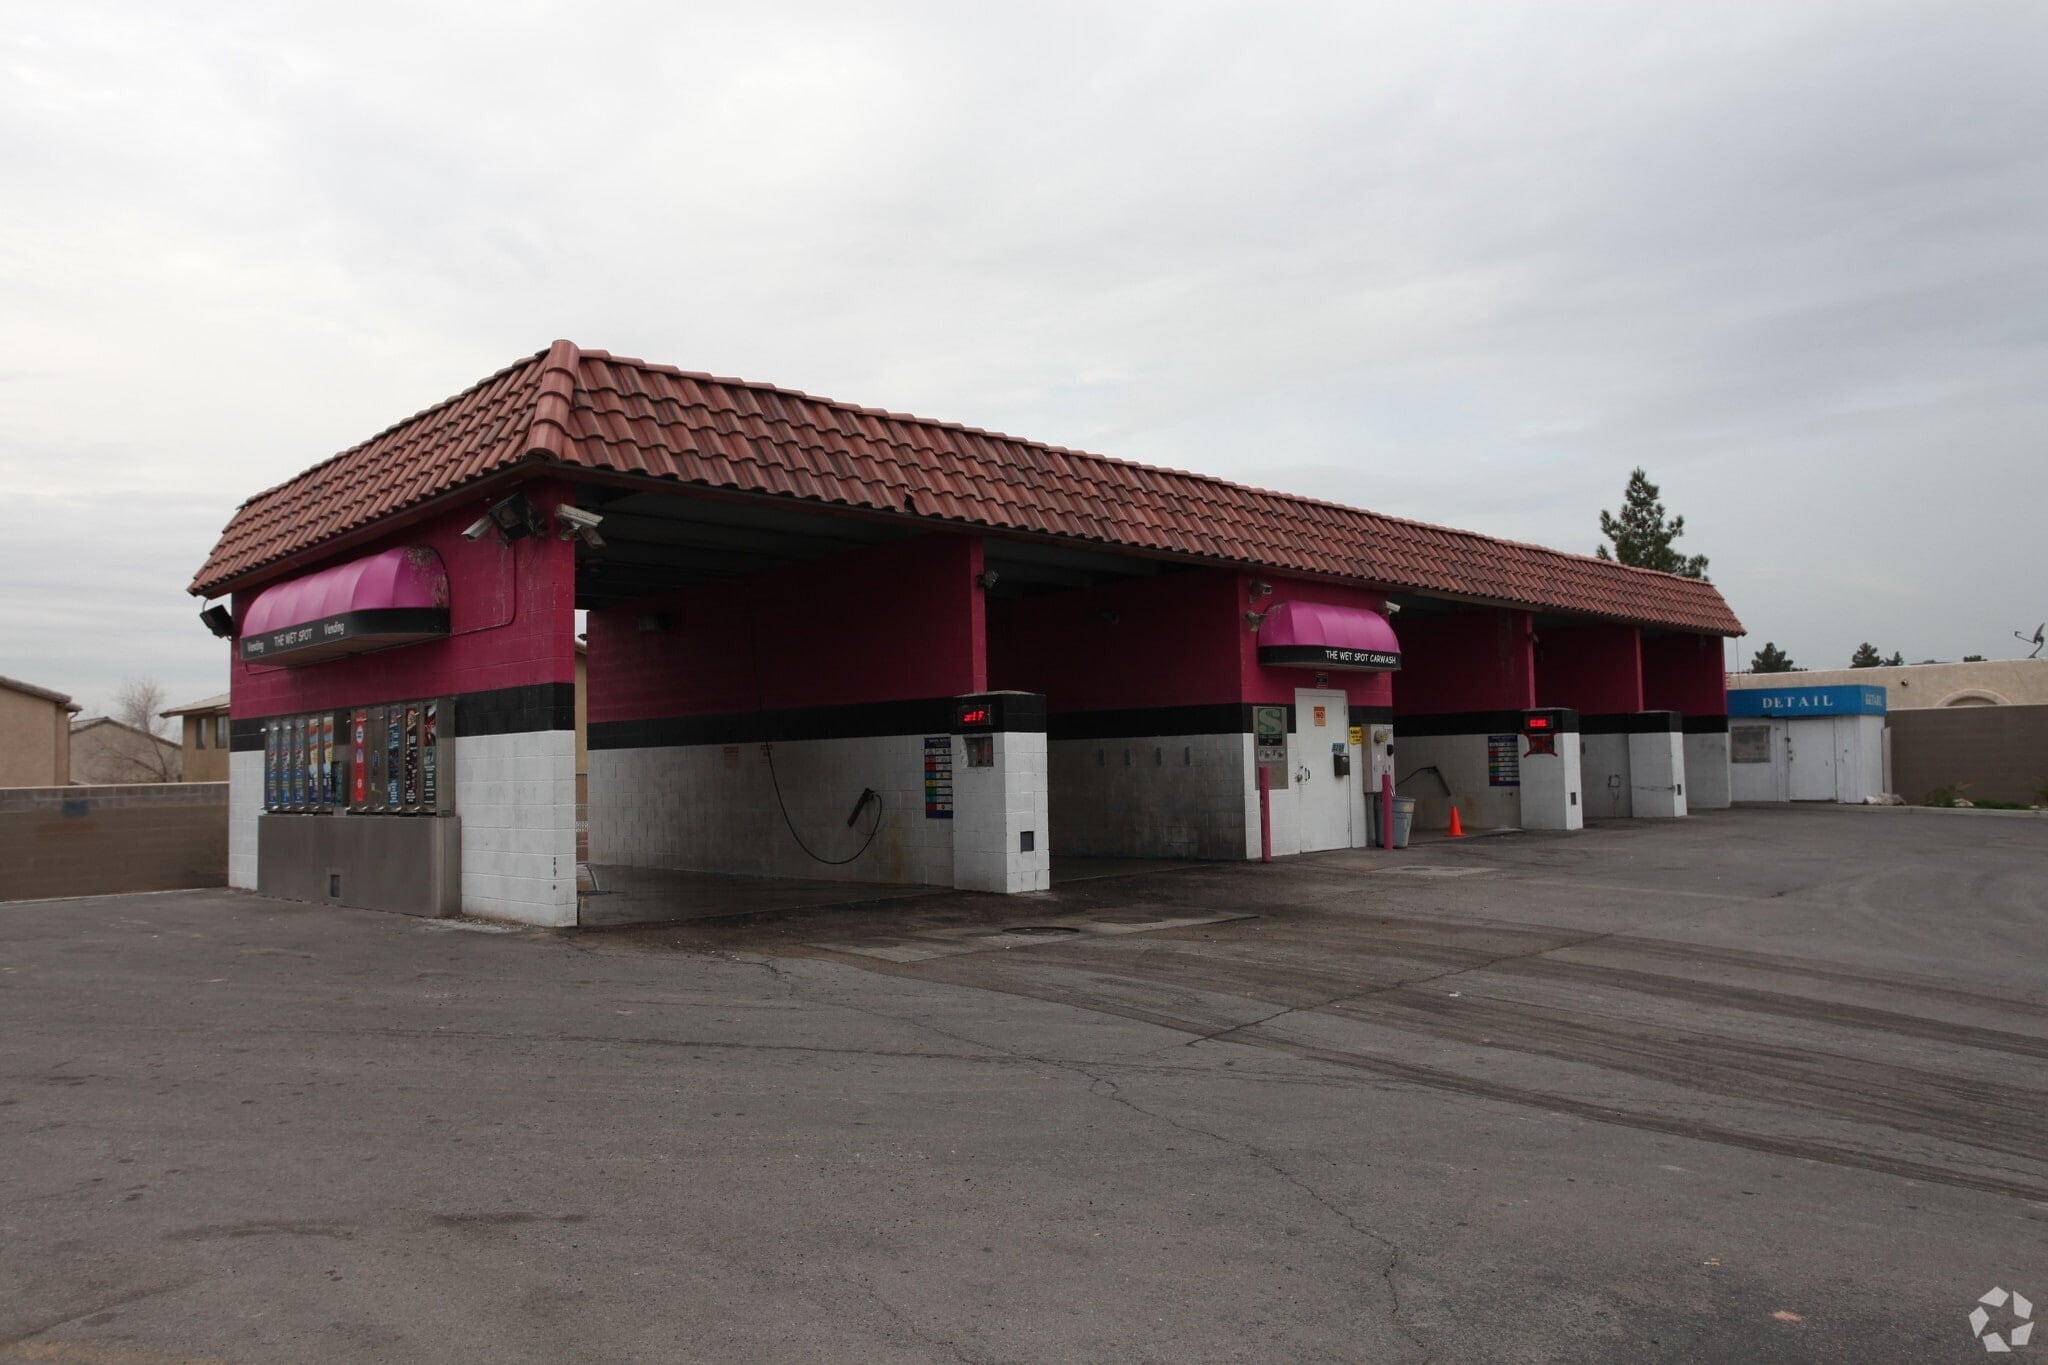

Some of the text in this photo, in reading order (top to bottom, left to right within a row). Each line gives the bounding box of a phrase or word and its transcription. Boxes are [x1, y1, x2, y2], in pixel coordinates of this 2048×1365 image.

[274, 634, 285, 646] THE
[285, 632, 297, 645] WET
[298, 628, 312, 642] SPOT
[324, 621, 345, 636] Vending
[1325, 650, 1396, 664] THE WET SPOT CARWASH
[1763, 695, 1833, 708] DETAIL
